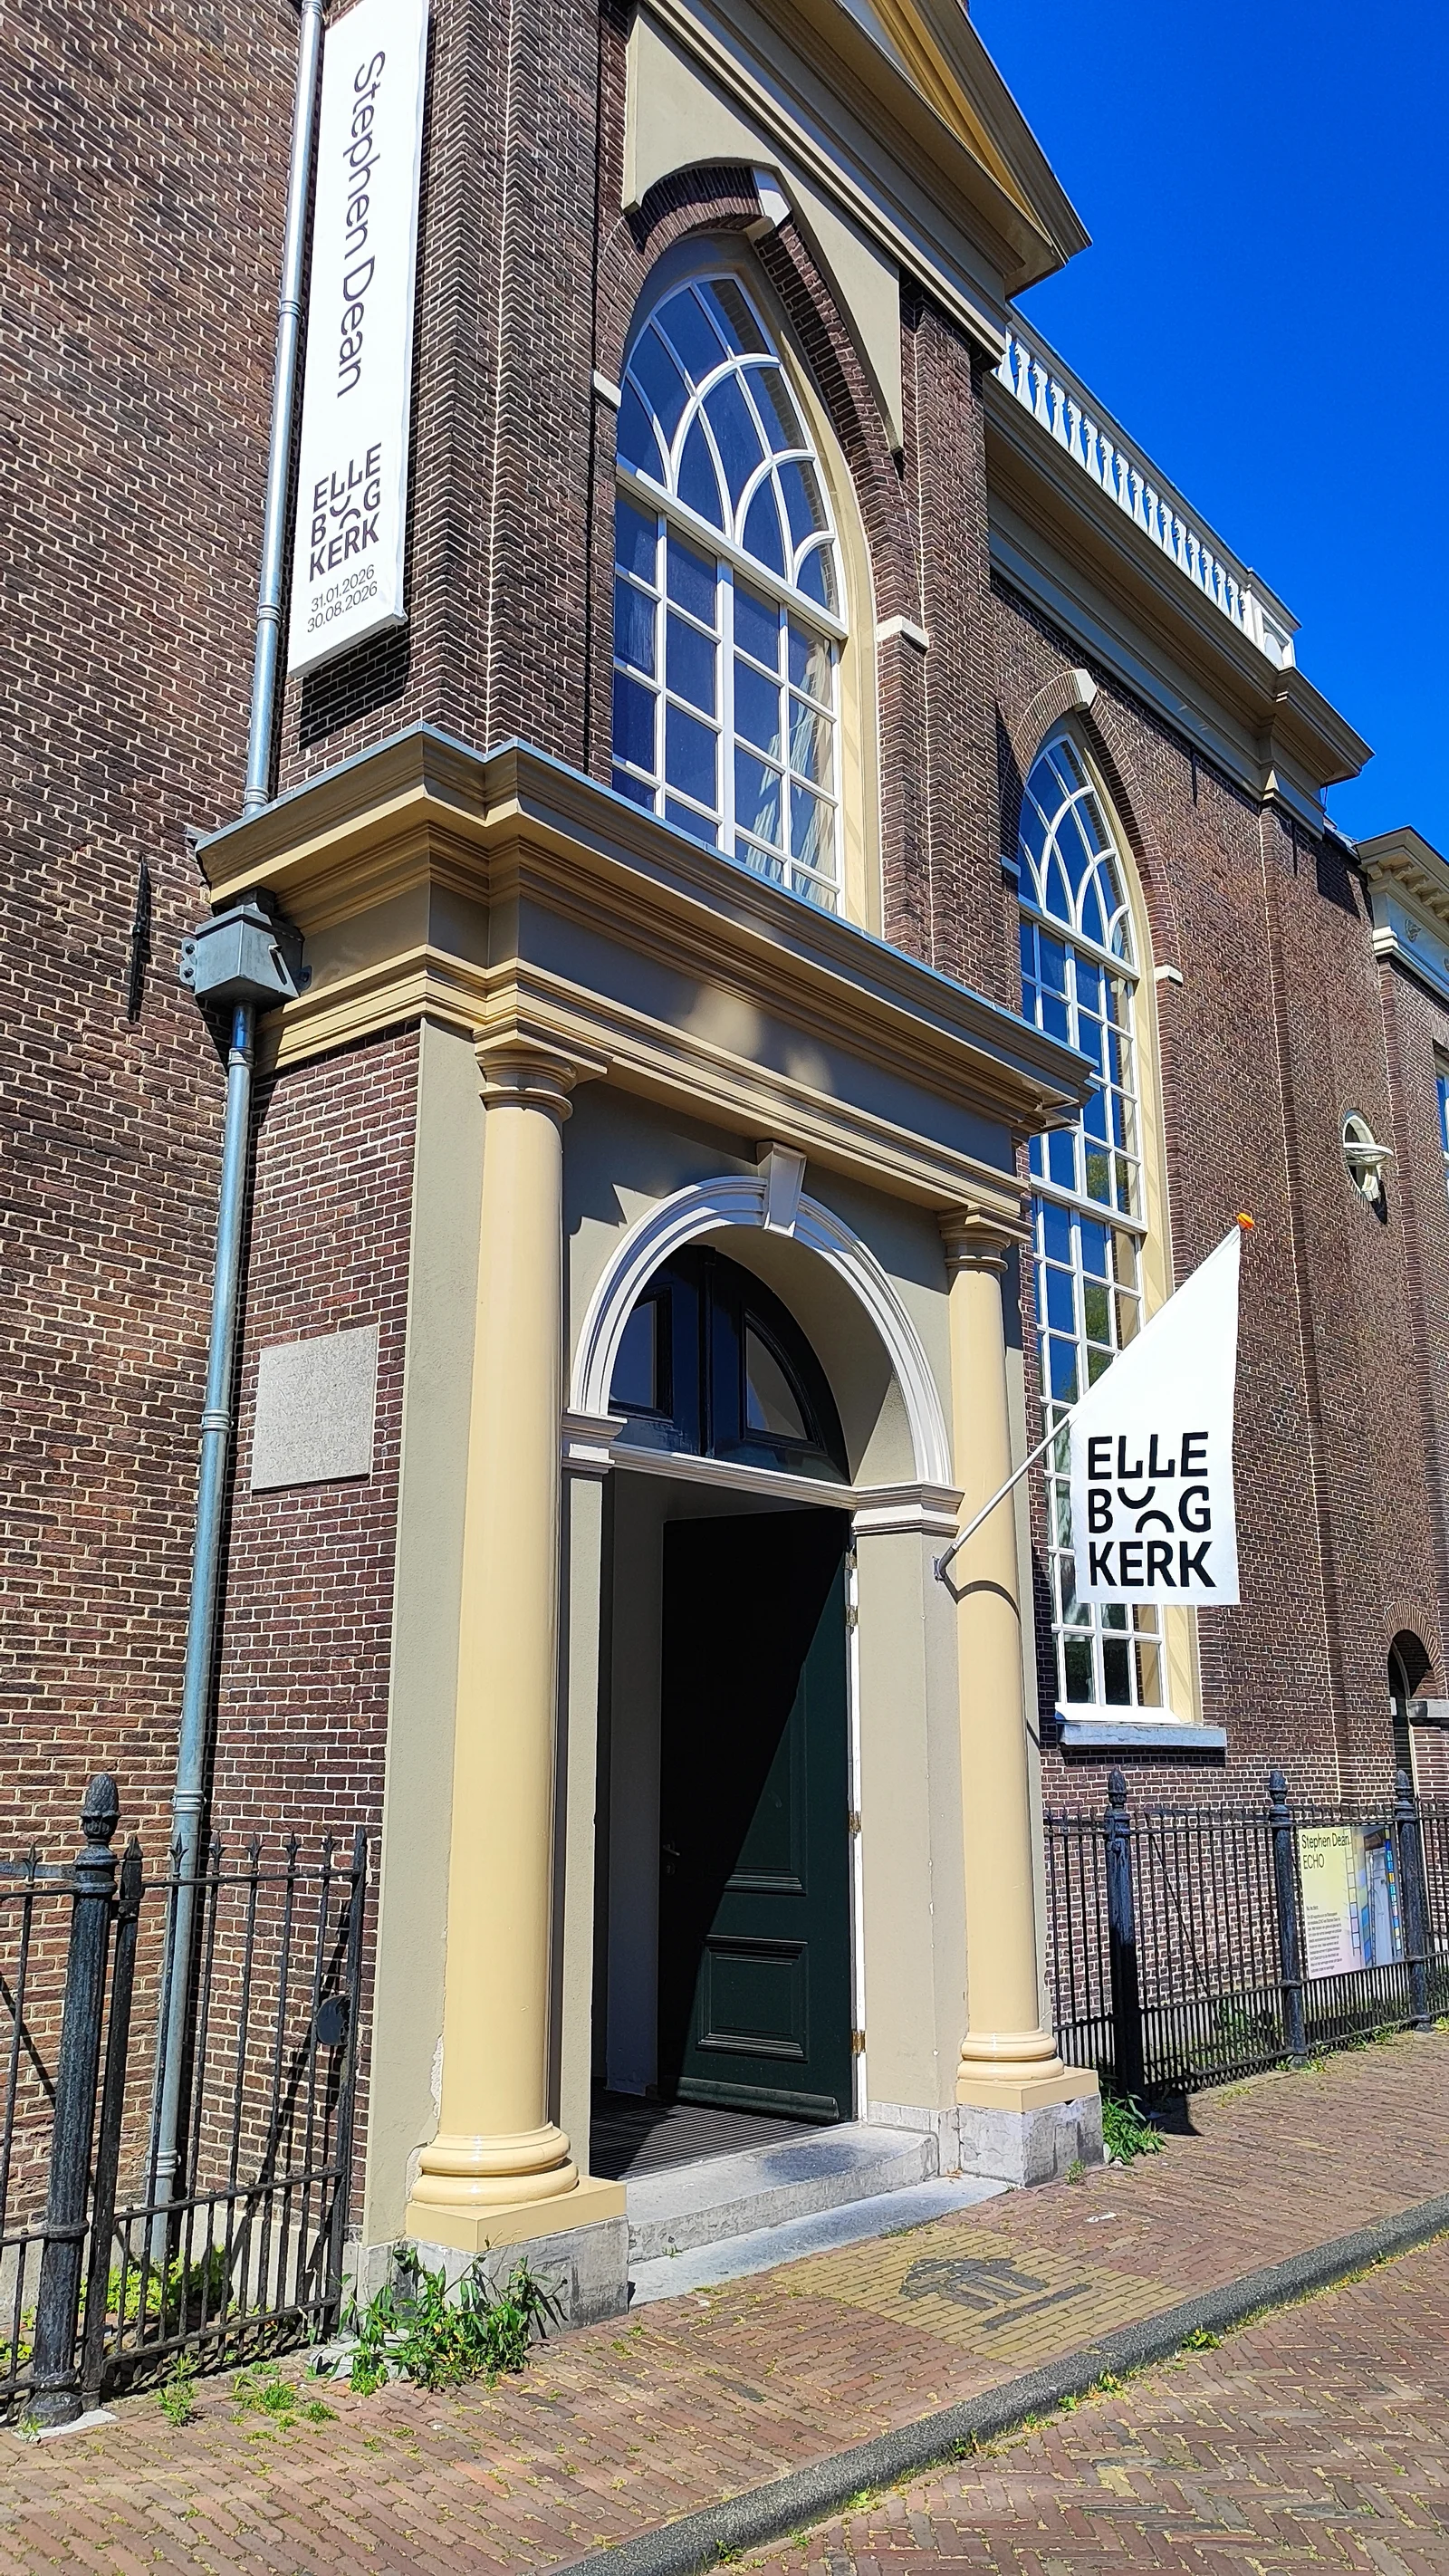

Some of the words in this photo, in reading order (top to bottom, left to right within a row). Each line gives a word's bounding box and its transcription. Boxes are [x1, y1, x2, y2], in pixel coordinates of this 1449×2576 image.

[342, 51, 386, 260] Stephen
[337, 255, 376, 399] Dean
[312, 442, 382, 514] ELLE
[309, 512, 380, 582] KERK
[307, 581, 378, 633] 30.08.2026
[311, 564, 375, 612] 31.01.2026
[1088, 1431, 1209, 1480] ELLE
[1089, 1540, 1217, 1587] KERK
[1301, 1833, 1331, 1851] Stephen
[1331, 1832, 1350, 1846] Dean
[1303, 1853, 1325, 1870] ECHO
